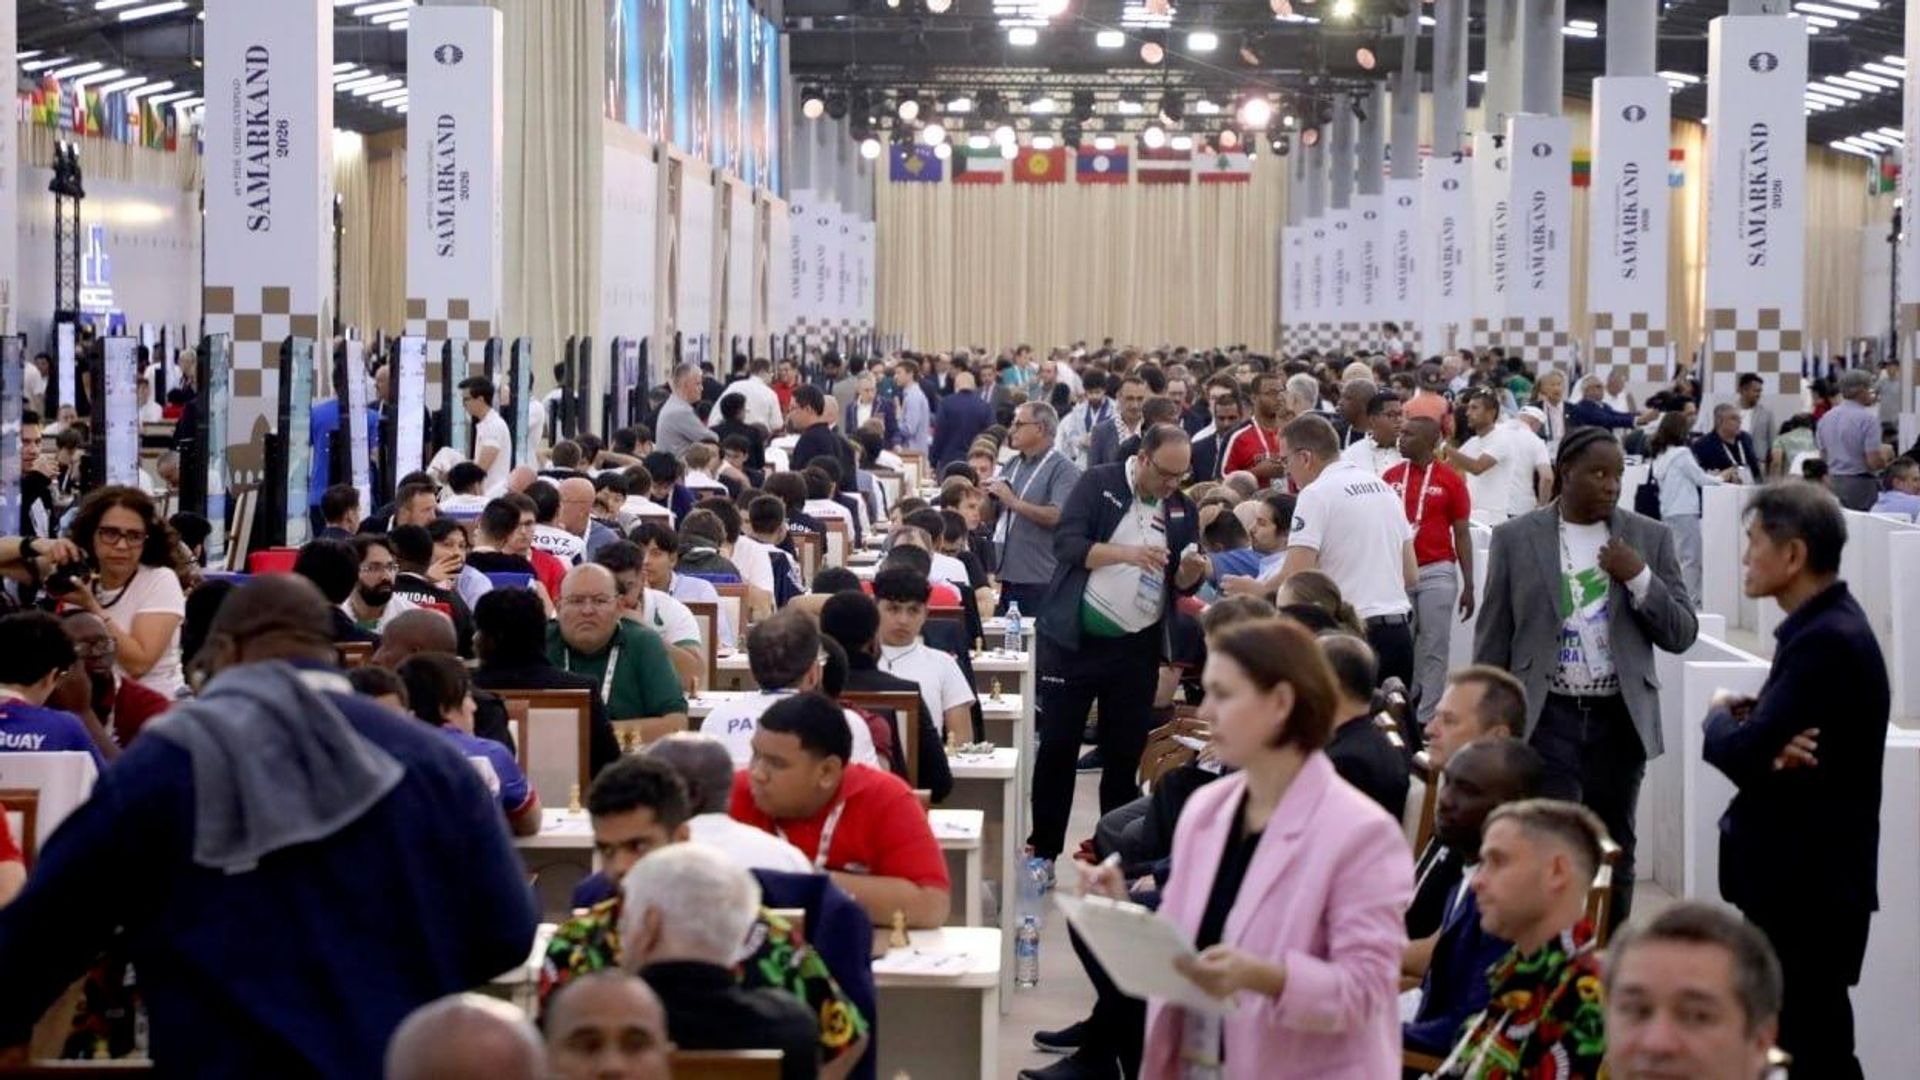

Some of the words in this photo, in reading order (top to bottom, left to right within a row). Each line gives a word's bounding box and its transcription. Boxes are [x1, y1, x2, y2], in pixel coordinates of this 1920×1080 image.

[245, 45, 271, 232] SAMARKAND
[276, 119, 289, 158] 2026
[436, 114, 456, 257] SAMARKAND
[459, 171, 470, 201] 2026
[1621, 162, 1638, 280] SAMARKAND
[1748, 122, 1768, 266] SAMARKAND
[1771, 179, 1782, 209] 2026
[1443, 216, 1454, 297] SAMARKAND
[1494, 201, 1507, 293] SAMARKAND
[1532, 190, 1546, 290] SAMARKAND
[728, 718, 752, 734] PA
